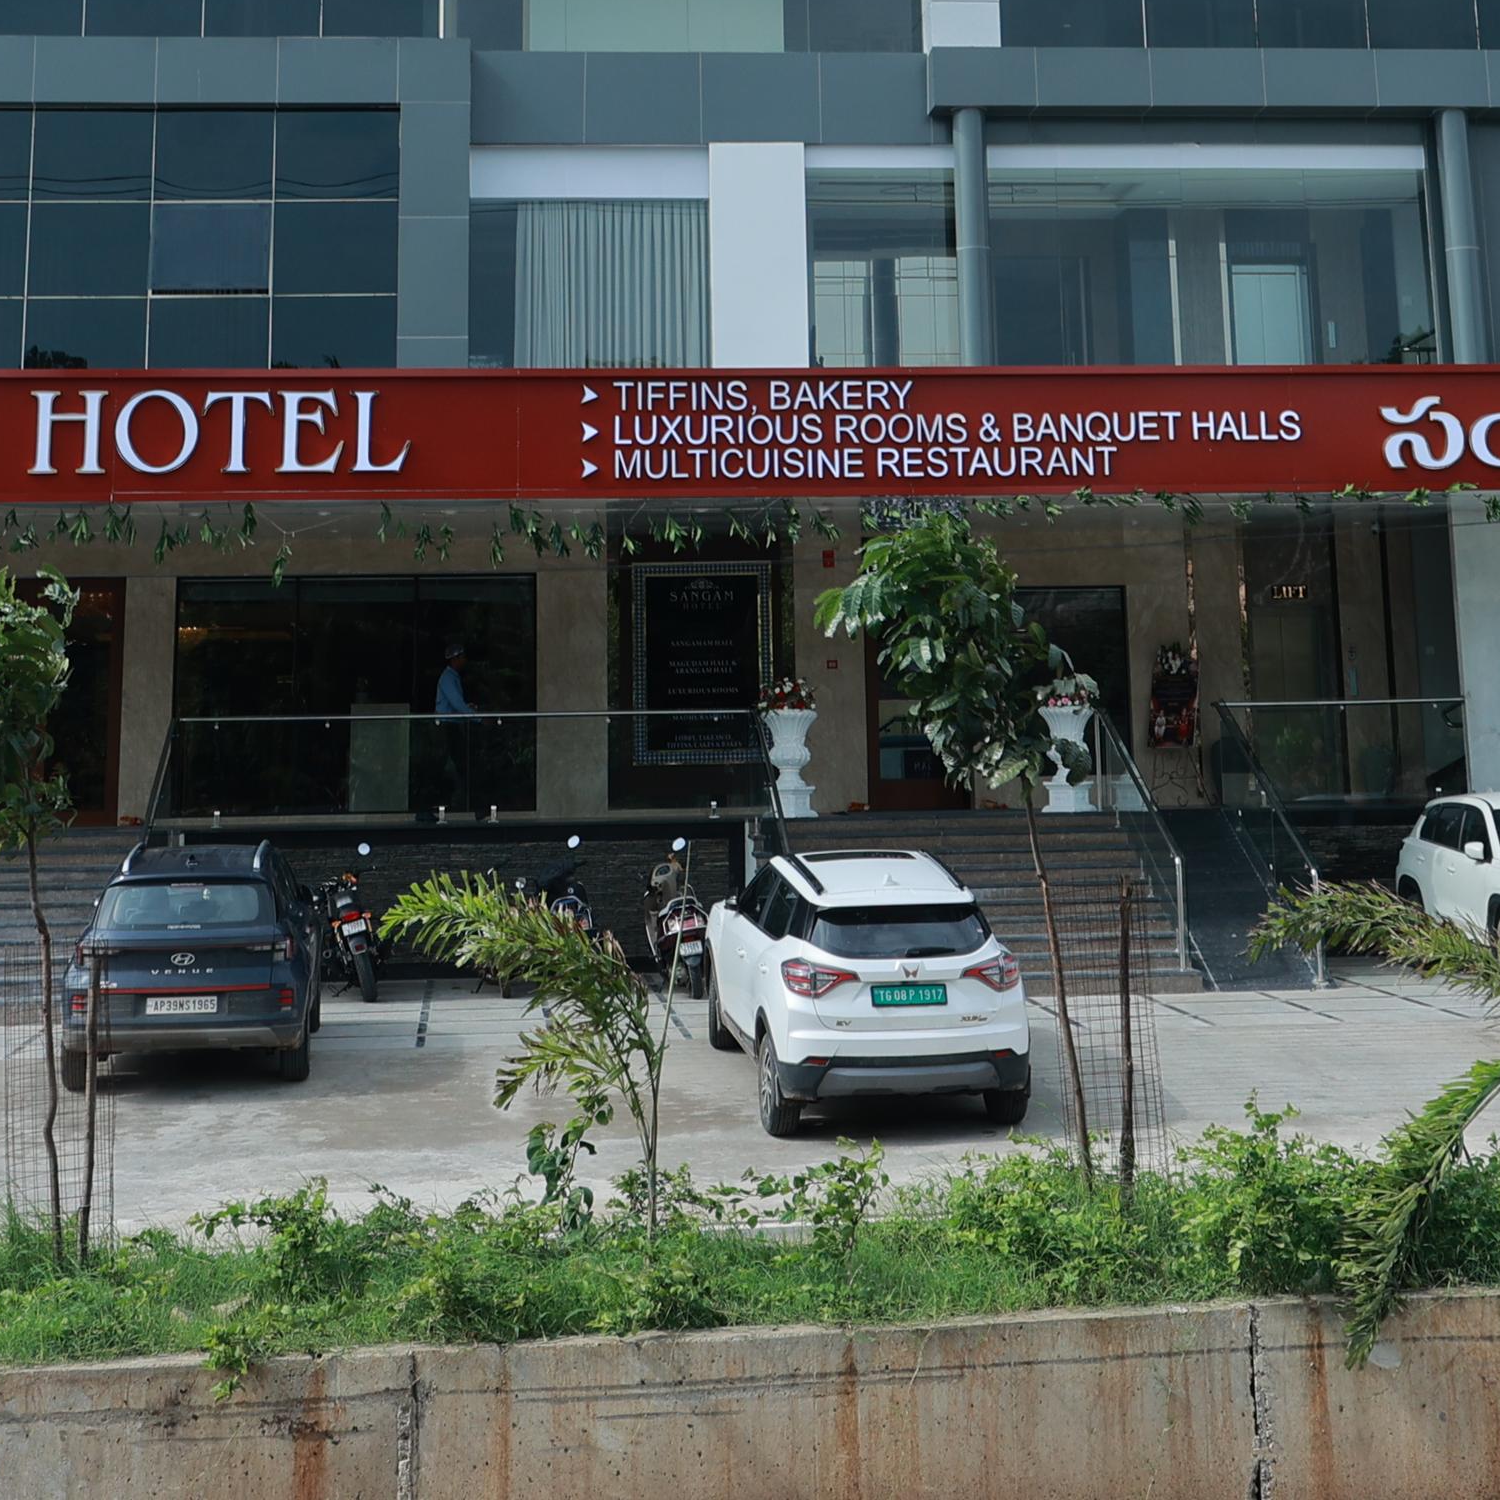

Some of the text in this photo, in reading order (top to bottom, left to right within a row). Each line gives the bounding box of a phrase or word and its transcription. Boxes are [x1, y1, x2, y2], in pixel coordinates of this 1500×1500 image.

[613, 380, 914, 416] TIFFINS, BAKERY
[27, 387, 412, 476] HOTEL
[613, 409, 1302, 447] LUXURIOUS ROOMS & BANQUET HALLS
[613, 446, 1119, 481] MULTICUISINE RESTAURANT
[669, 590, 735, 602] SANGAM
[1273, 585, 1307, 599] LIFT
[151, 967, 214, 975] VENUE
[152, 998, 216, 1012] AP39NS1965
